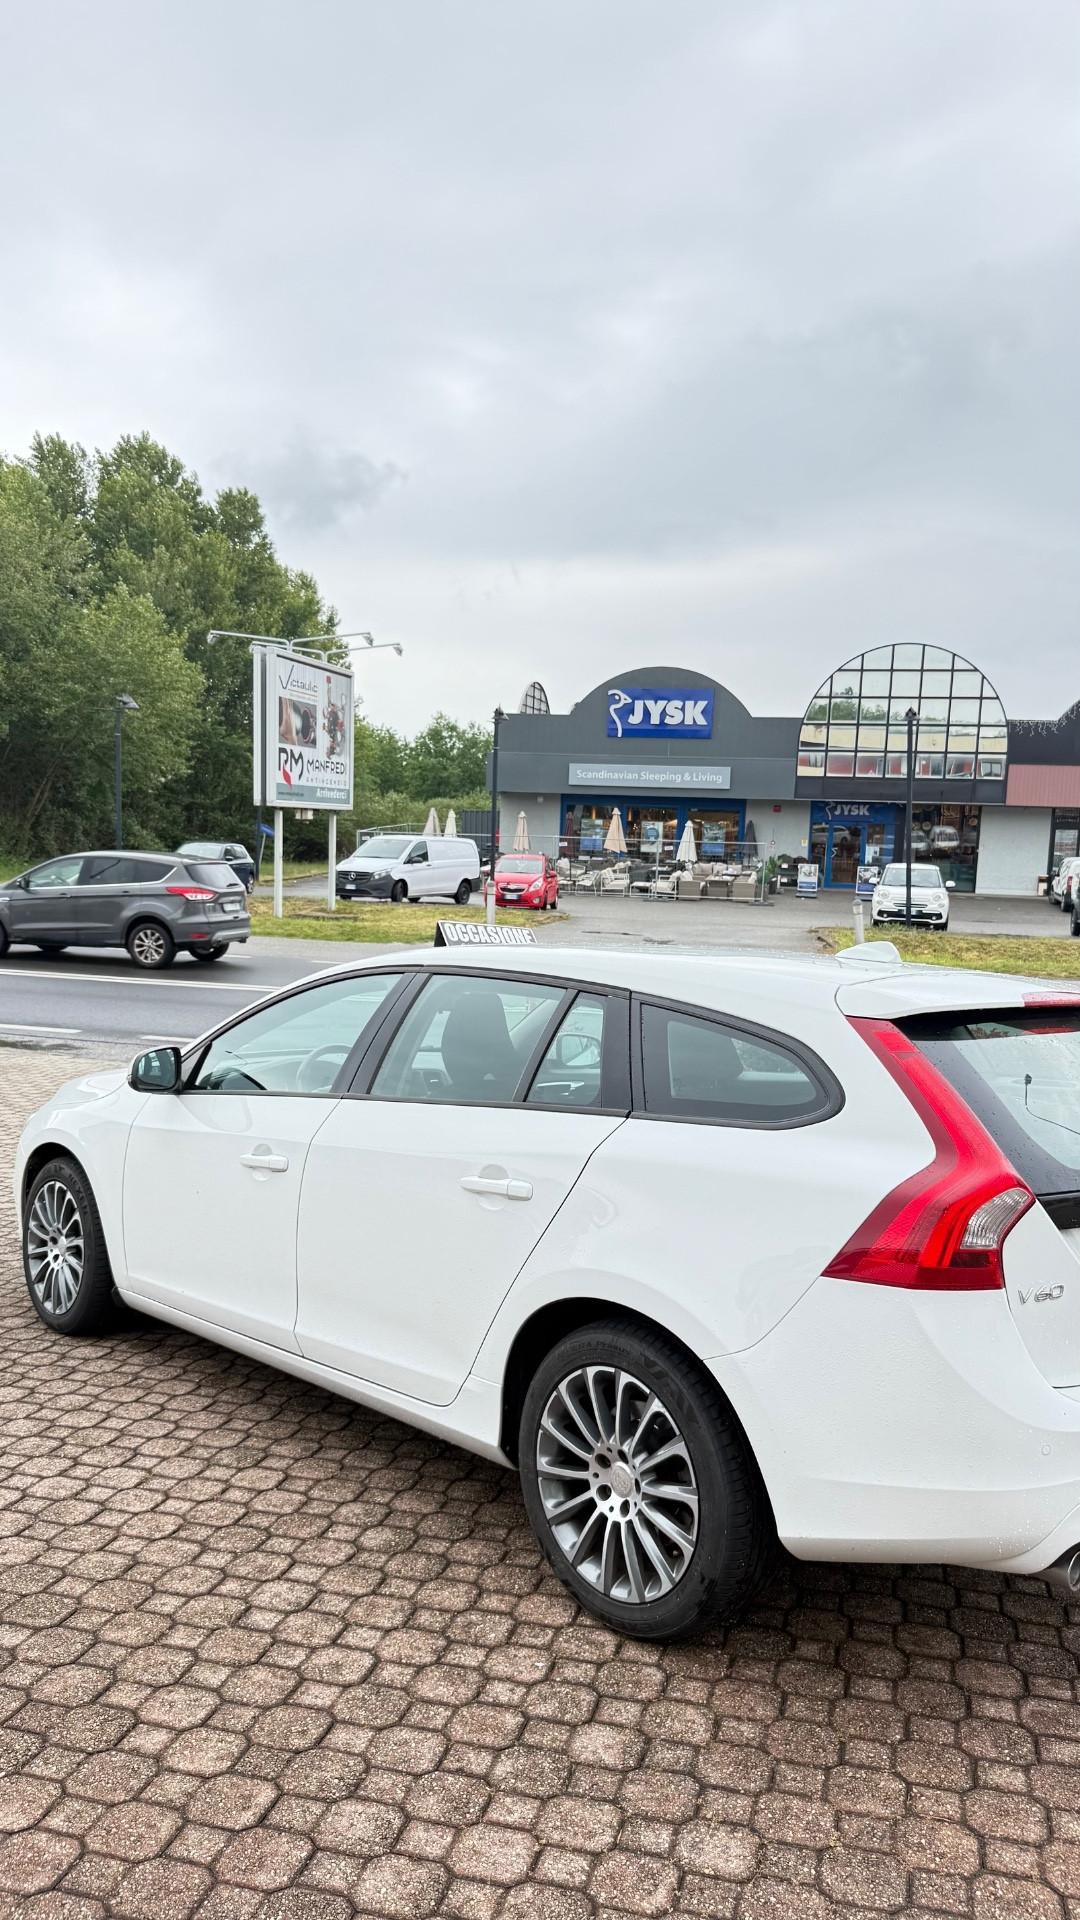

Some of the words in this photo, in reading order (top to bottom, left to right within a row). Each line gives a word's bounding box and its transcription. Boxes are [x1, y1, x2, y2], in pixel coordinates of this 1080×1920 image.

[627, 700, 708, 725] JYSK
[576, 769, 639, 782] Scandinavian
[639, 771, 682, 784] Sleeping
[683, 772, 691, 782] &
[692, 772, 722, 784] Living
[833, 804, 870, 816] JYSK
[443, 923, 533, 944] OCCASIONE
[1018, 1284, 1064, 1304] V60
